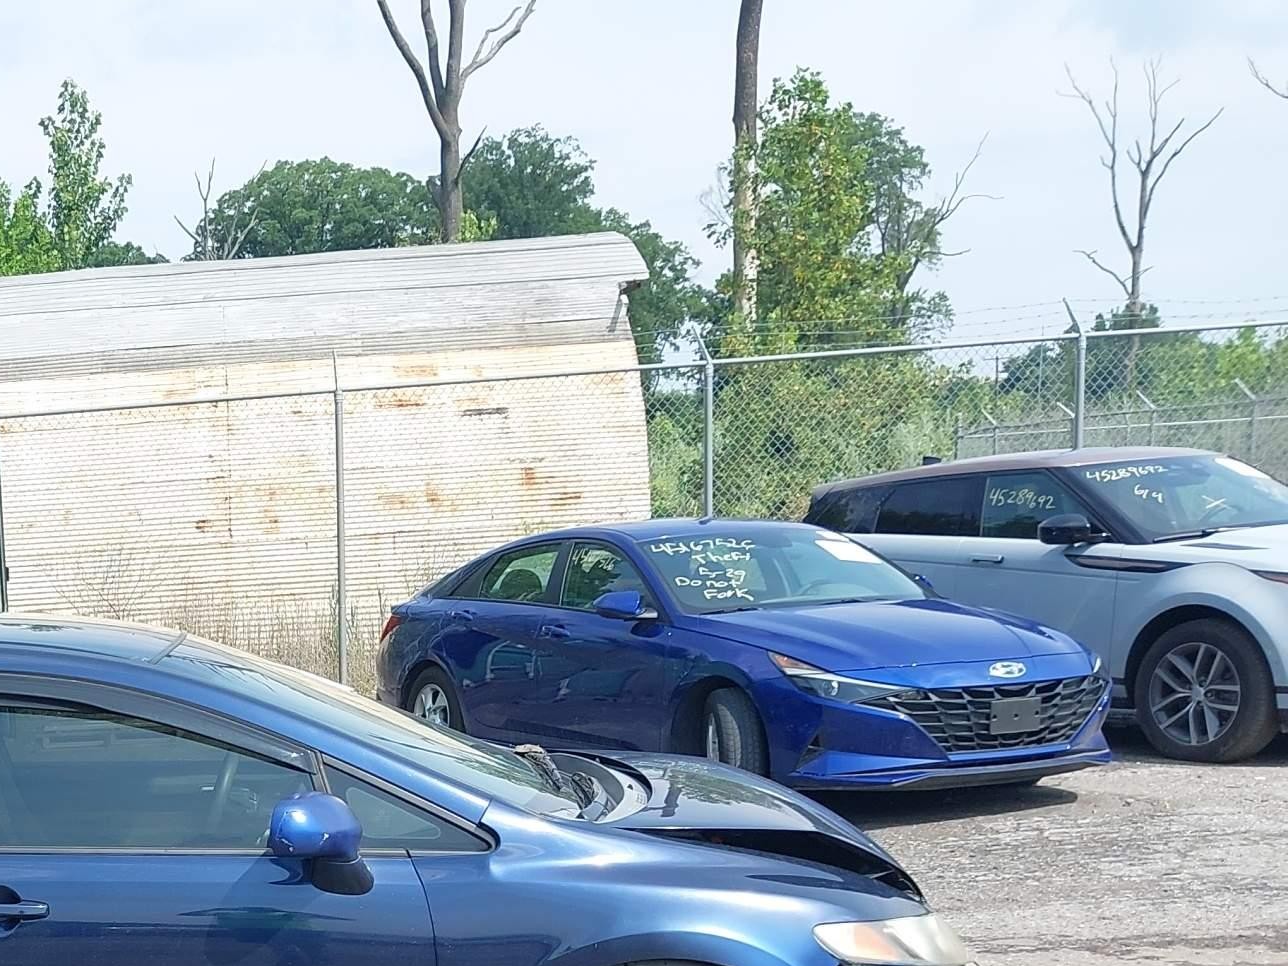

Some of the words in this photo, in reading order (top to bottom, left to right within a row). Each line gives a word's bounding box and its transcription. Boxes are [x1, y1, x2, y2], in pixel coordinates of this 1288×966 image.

[1086, 465, 1169, 483] 45289692
[989, 487, 1056, 510] 45289692
[674, 576, 702, 586] Do
[705, 579, 741, 587] not
[703, 588, 754, 601] Fork
